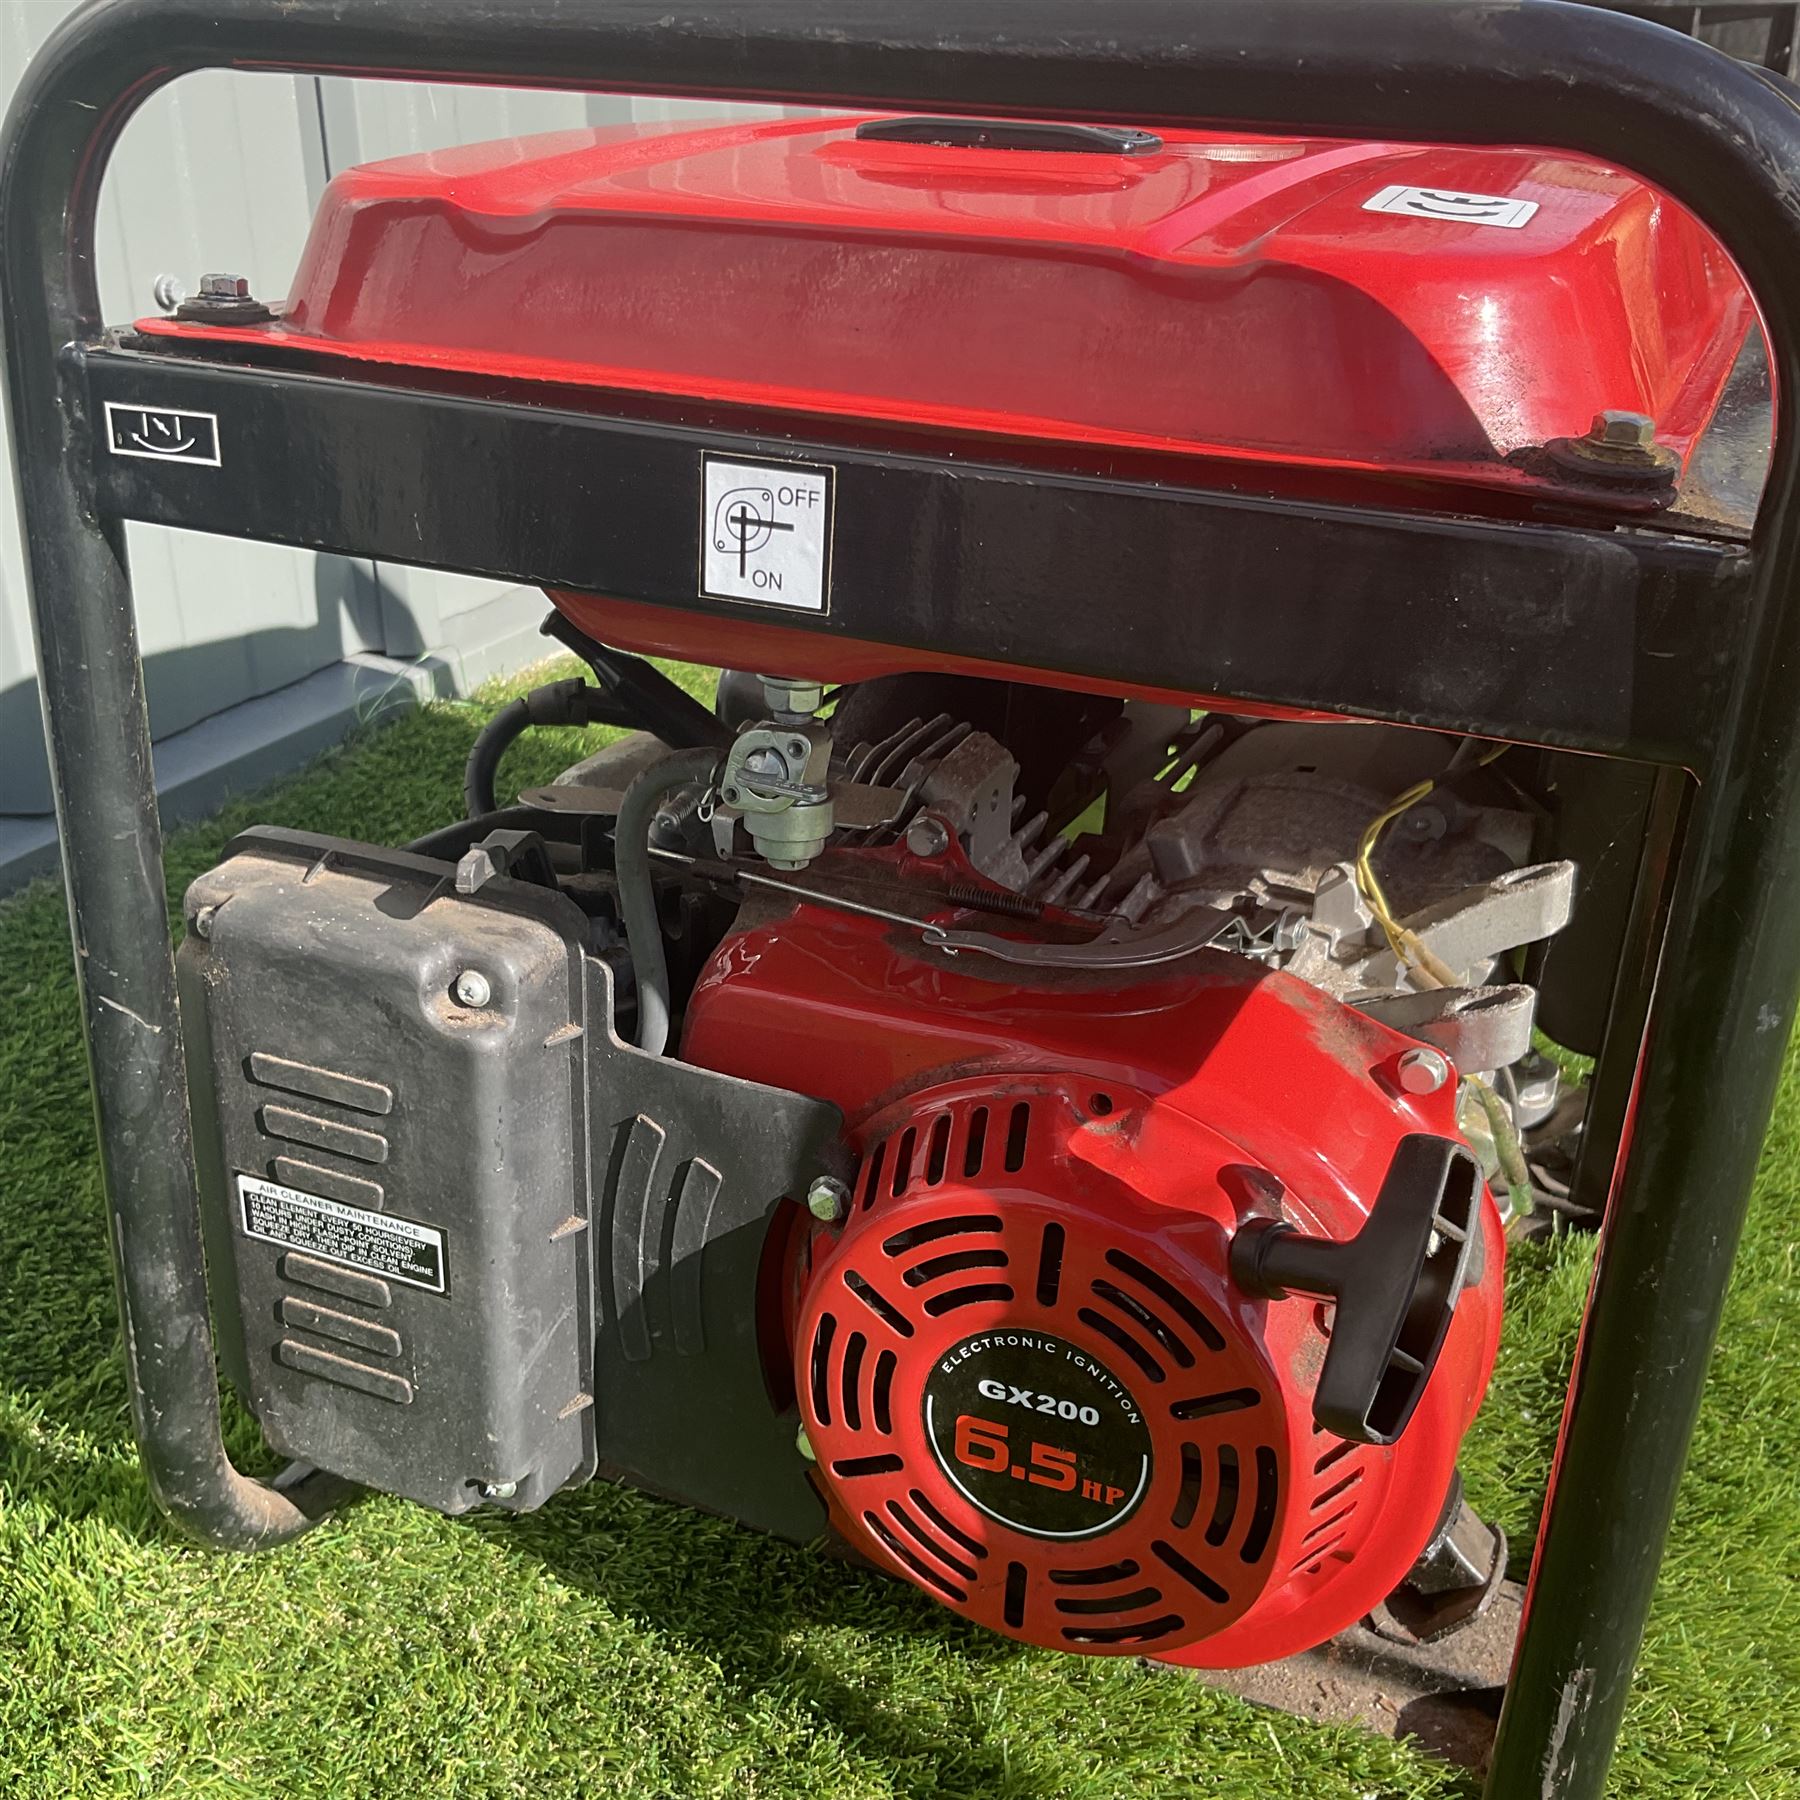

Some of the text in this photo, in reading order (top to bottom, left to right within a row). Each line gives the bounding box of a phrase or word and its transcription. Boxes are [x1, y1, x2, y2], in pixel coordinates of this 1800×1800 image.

[778, 486, 820, 508] OFF
[752, 569, 783, 591] ON
[250, 1194, 277, 1207] CLEAN
[281, 1202, 318, 1218] ELEMENT
[321, 1214, 349, 1228] EVERY
[352, 1223, 362, 1232] 50
[251, 1202, 261, 1210] 10
[263, 1206, 292, 1219] HOURS
[295, 1213, 325, 1228] UNDER
[327, 1223, 355, 1237] DUSTY
[251, 1209, 276, 1221] WASH
[279, 1216, 288, 1225] IN
[289, 1219, 310, 1232] HIGH
[312, 1228, 370, 1249] FLASH-POINT
[260, 1184, 421, 1237] AIR CLEANER MAINTENANCE
[252, 1217, 290, 1234] SQUEEZE
[316, 1235, 338, 1248] THEN
[341, 1242, 356, 1252] DIP
[358, 1248, 368, 1256] IN
[370, 1251, 398, 1266] CLEAN
[401, 1260, 434, 1277] ENGINE
[253, 1225, 267, 1235] OIL
[269, 1230, 287, 1240] AND
[289, 1235, 327, 1251] SQUEEZE
[330, 1247, 348, 1258] OUT
[351, 1253, 385, 1269] EXCESS
[941, 1336, 1140, 1425] ELECTRONIC IGNITION
[978, 1379, 1100, 1426] GX200
[954, 1415, 1125, 1506] 6.5 HP
